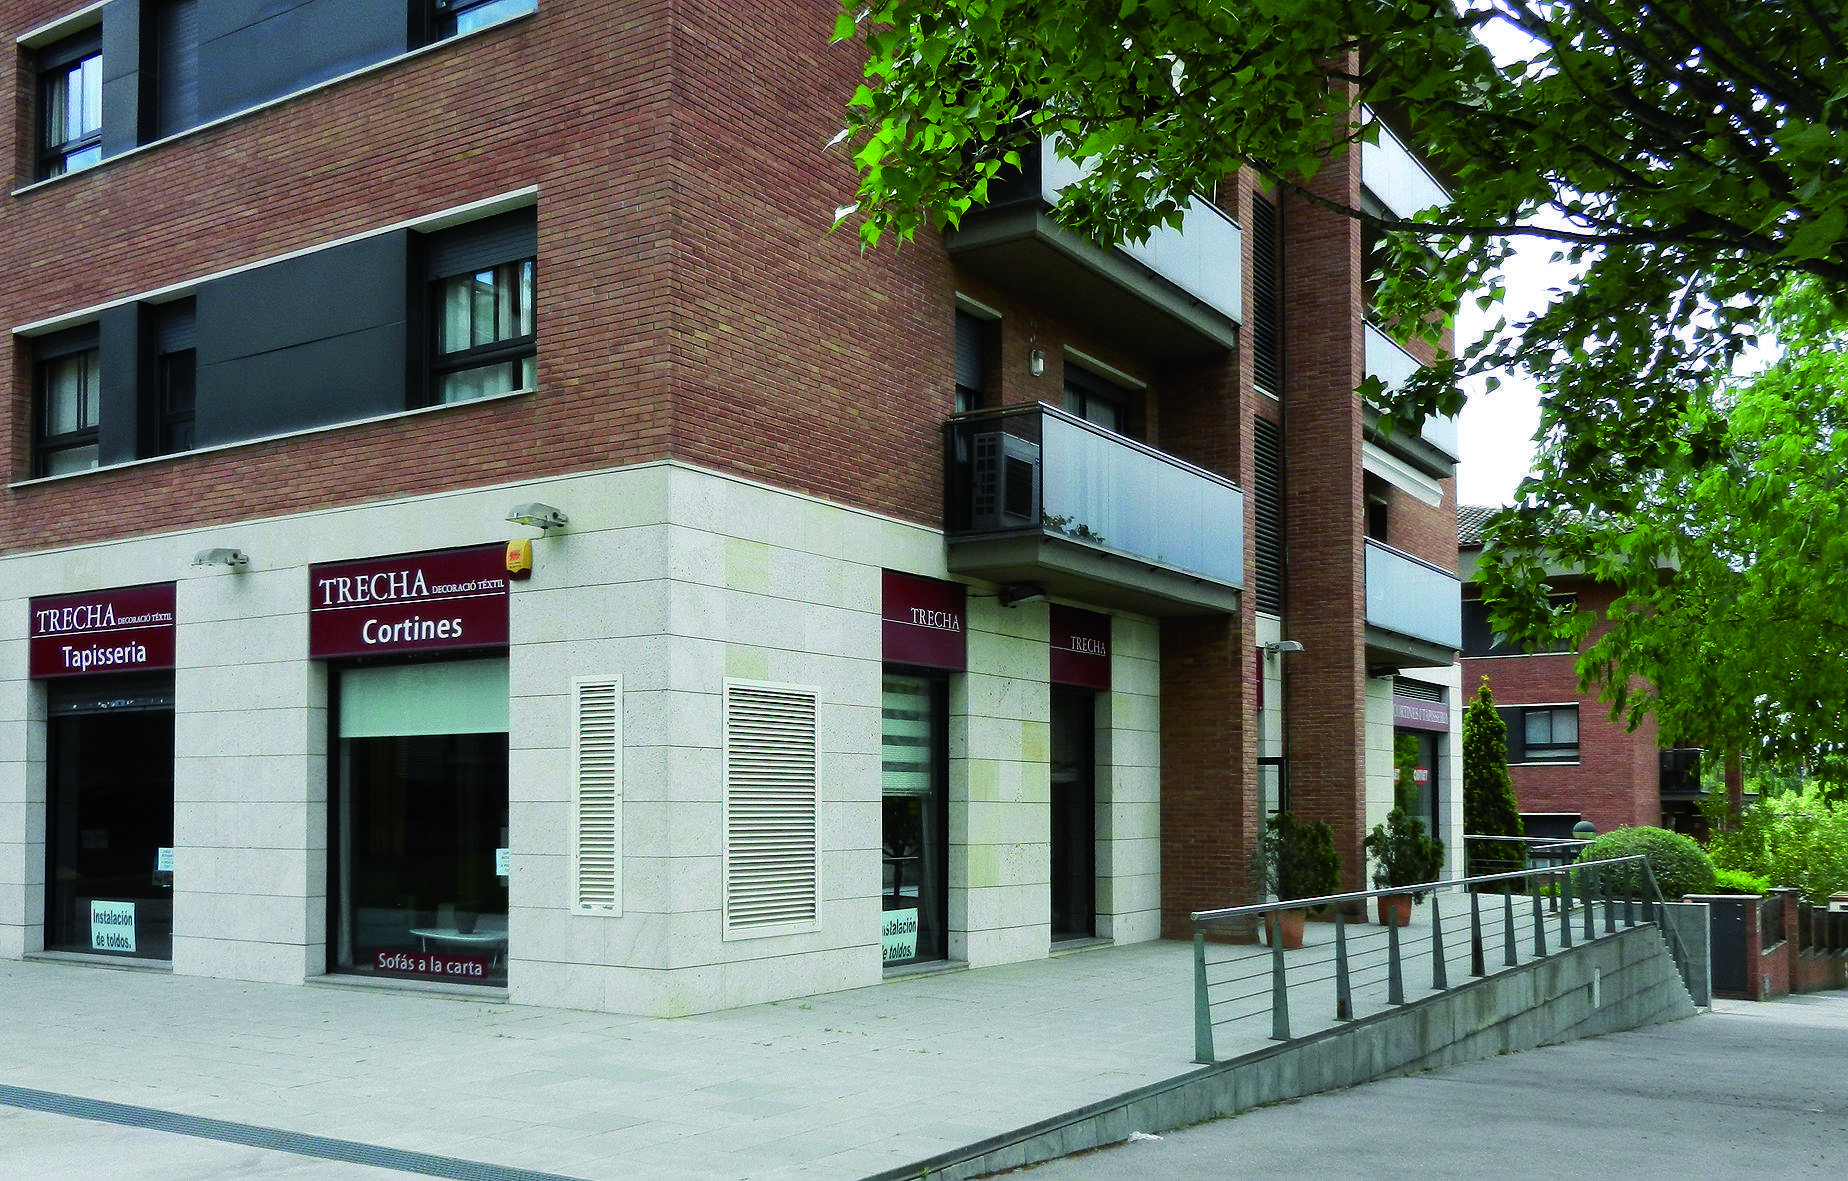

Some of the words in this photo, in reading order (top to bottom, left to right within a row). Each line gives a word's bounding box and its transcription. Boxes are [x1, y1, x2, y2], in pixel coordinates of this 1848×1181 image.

[319, 569, 430, 605] TRECHA
[432, 580, 477, 594] DECORACIÓ
[477, 579, 504, 590] TÉXTIL
[36, 603, 116, 633] TRECHA
[117, 613, 151, 625] DECORACIÓ
[911, 607, 960, 631] TRECHA
[362, 616, 463, 645] Cortines
[62, 640, 147, 672] Tapisseria
[1071, 636, 1106, 655] TRECHA
[93, 909, 133, 925] Instalación
[882, 917, 917, 936] nstalación
[96, 932, 105, 947] de
[106, 933, 132, 949] toldos.
[378, 953, 415, 970] Sofás
[418, 960, 426, 971] a
[430, 956, 442, 973] la
[446, 961, 483, 976] carta
